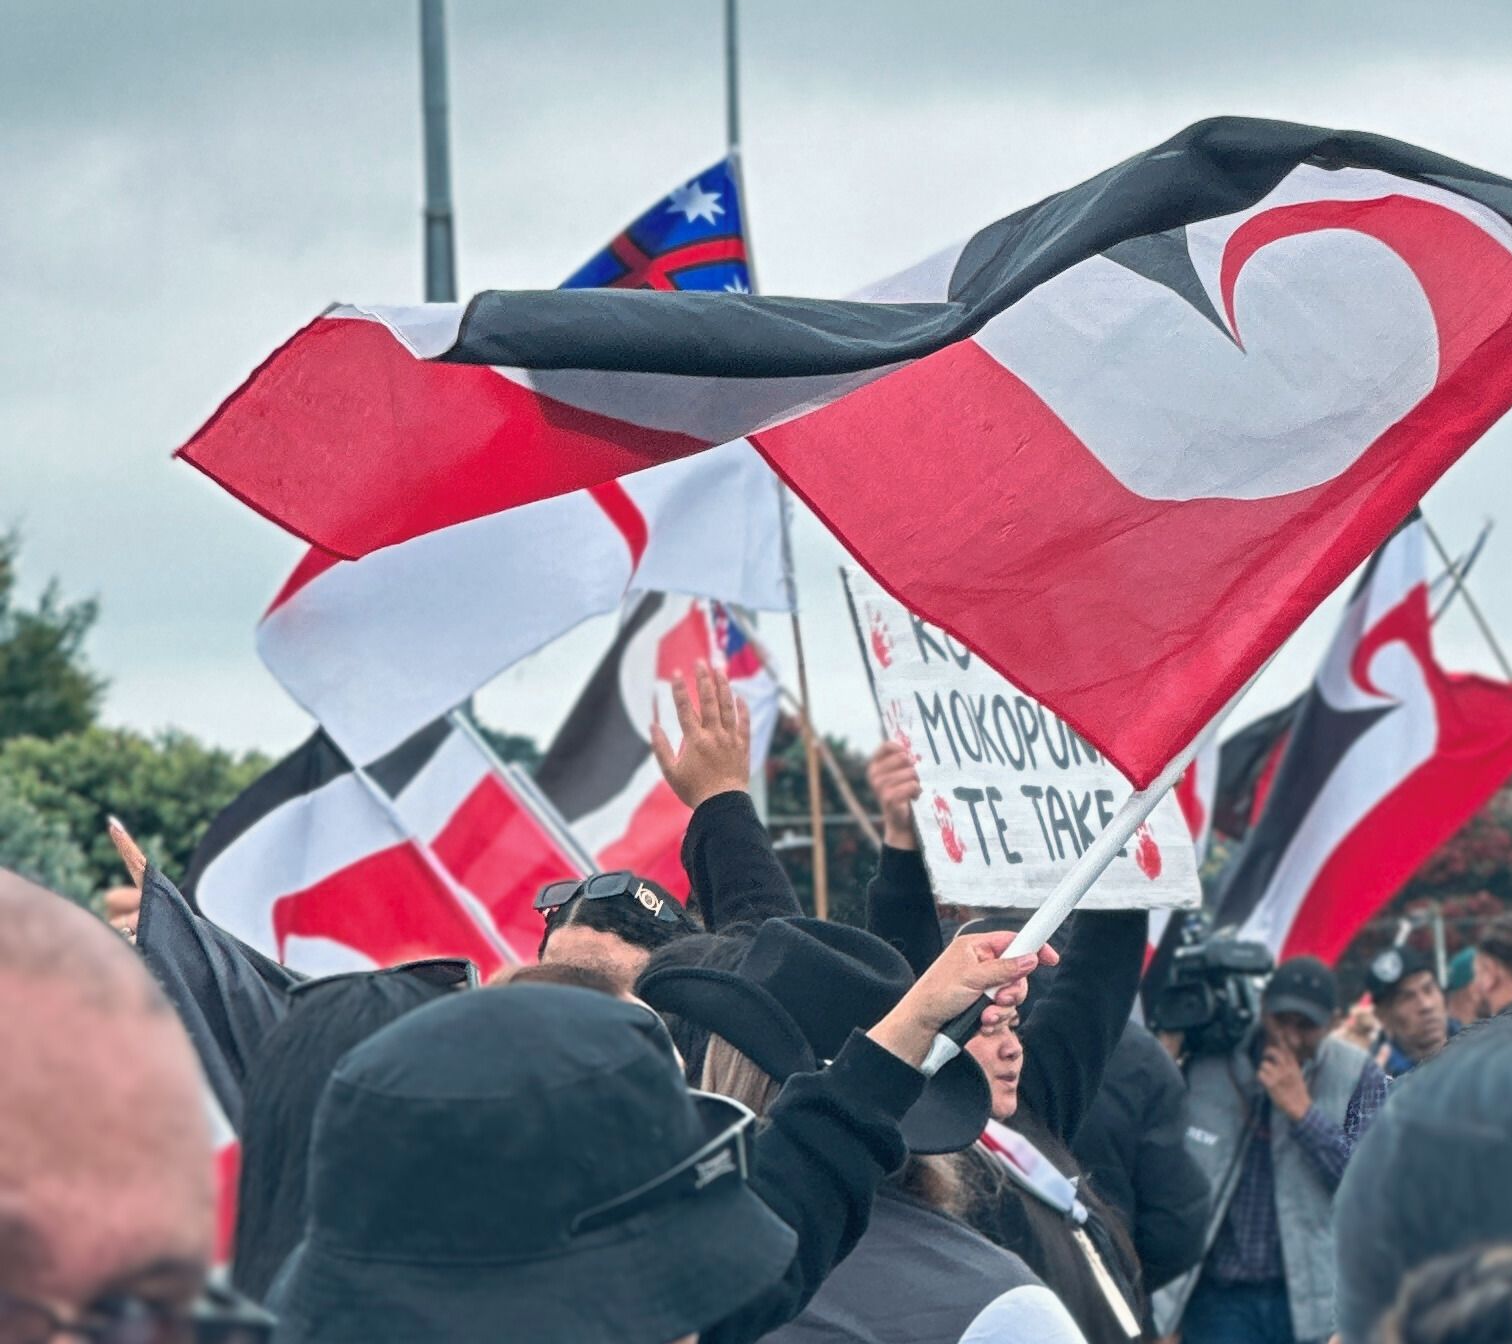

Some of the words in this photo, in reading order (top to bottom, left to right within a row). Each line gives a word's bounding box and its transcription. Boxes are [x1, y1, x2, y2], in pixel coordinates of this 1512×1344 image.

[914, 689, 1104, 771] MOKOPUN
[953, 786, 1023, 866] TE
[1020, 784, 1128, 862] TAKE
